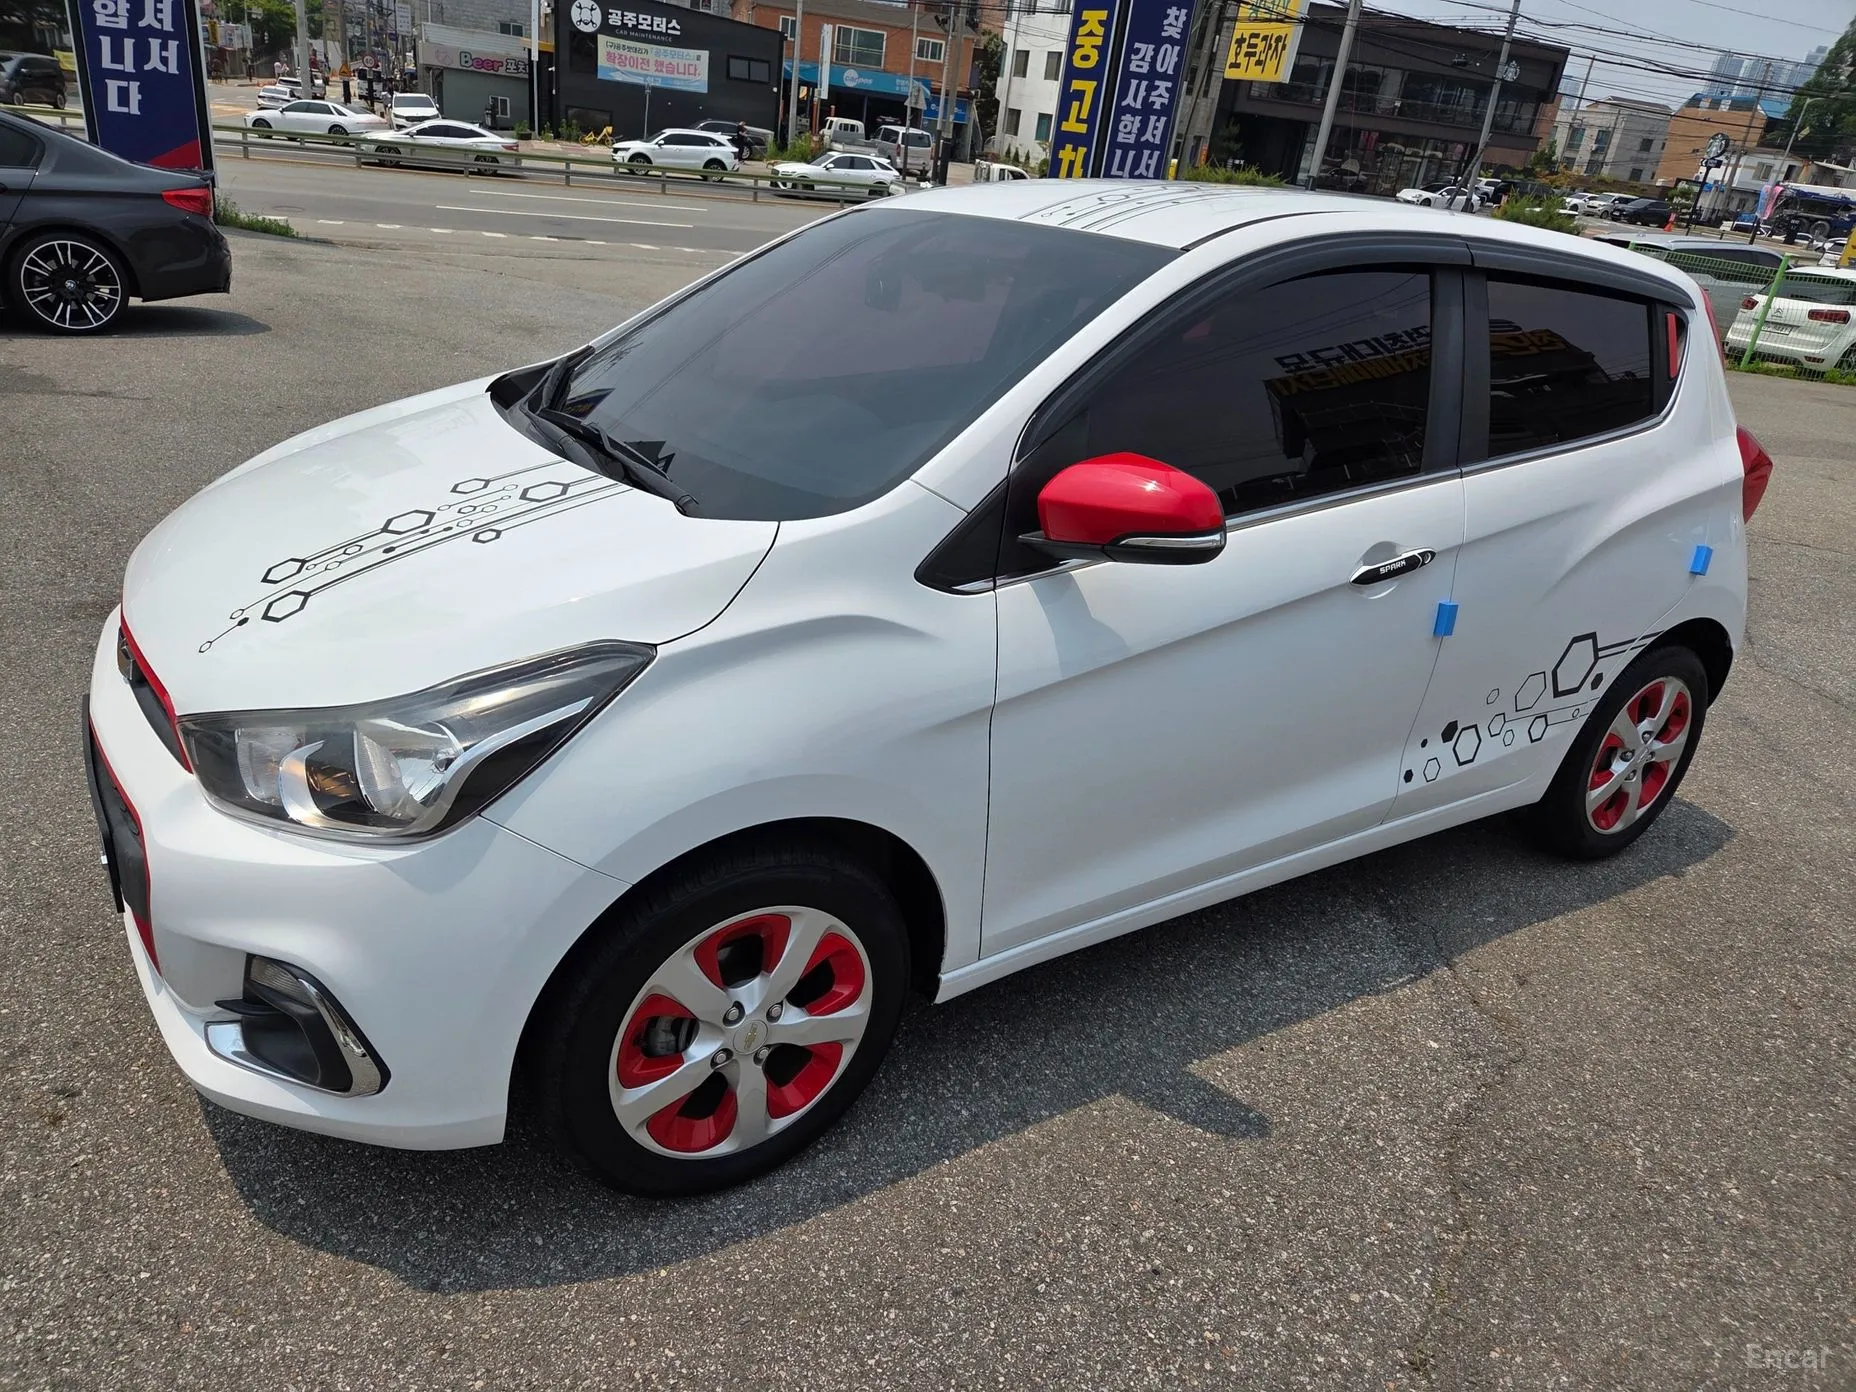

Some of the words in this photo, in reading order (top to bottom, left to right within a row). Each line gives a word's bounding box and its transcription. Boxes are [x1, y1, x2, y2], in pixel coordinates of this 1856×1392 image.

[608, 8, 681, 36] 공주모터스
[630, 30, 673, 42] MAINTENANCE
[460, 51, 504, 73] Beer
[606, 50, 650, 72] 확장이전
[1228, 32, 1288, 75] 호두과자
[1380, 559, 1407, 574] SPARK
